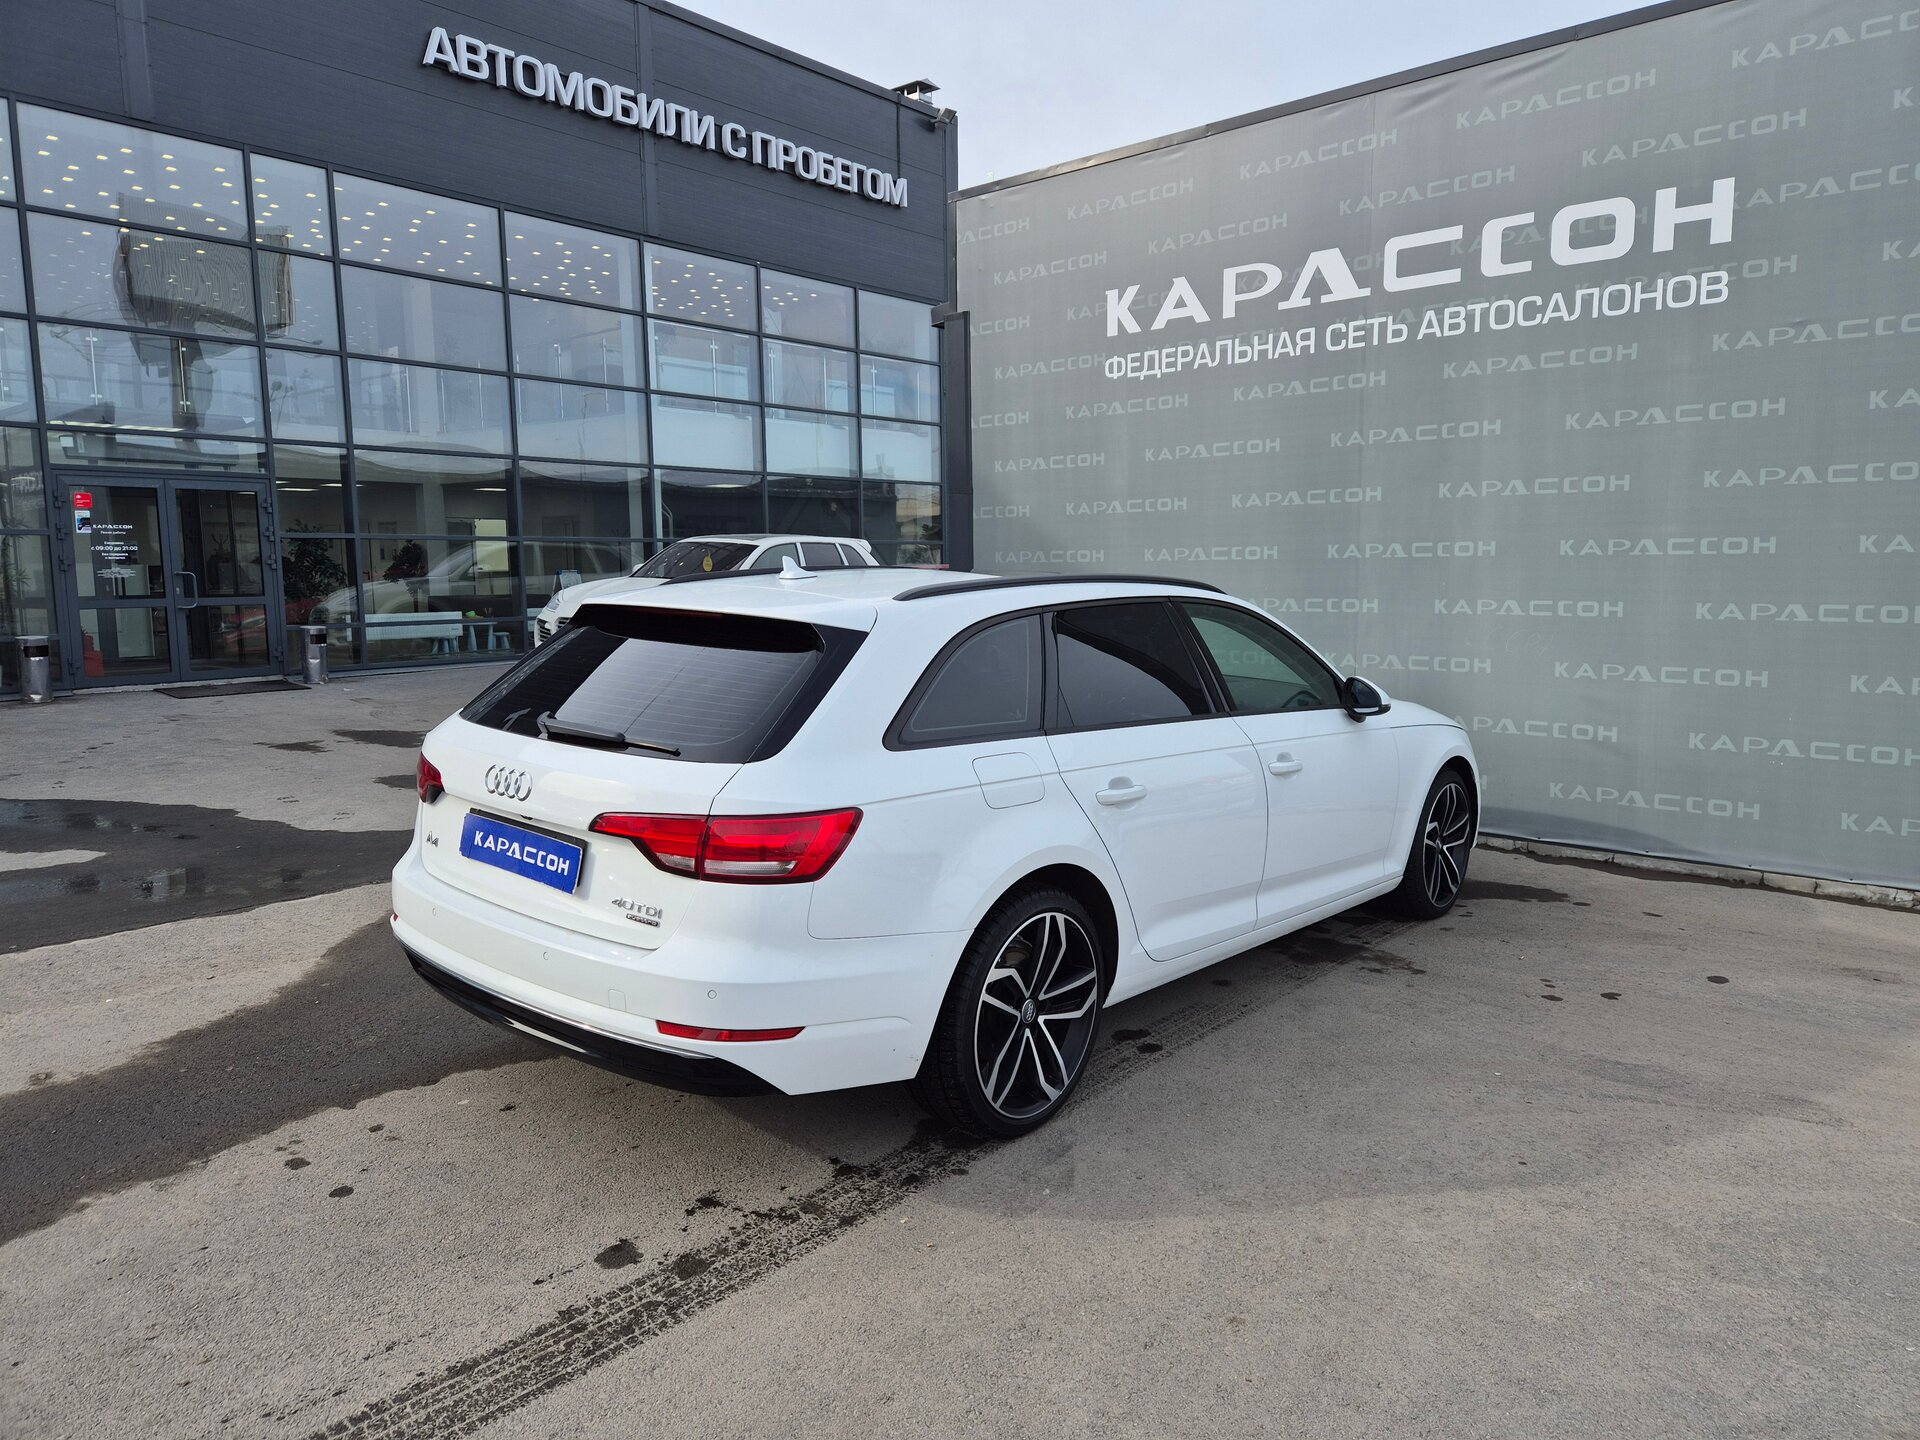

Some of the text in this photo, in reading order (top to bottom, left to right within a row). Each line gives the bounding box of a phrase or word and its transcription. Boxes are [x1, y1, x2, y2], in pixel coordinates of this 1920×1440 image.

[1456, 69, 1656, 129] КАРАССОН
[422, 26, 908, 207] АВТОМОБИЛИ С ПРОБЕГОМ
[1581, 108, 1807, 168] КАРАССОН
[1240, 128, 1397, 180] КАРАССОН
[1067, 177, 1194, 220] КАРАССОН
[1339, 164, 1515, 216] КАРАССОН
[1735, 161, 1920, 210] АРАСС
[1148, 212, 1288, 255] КАРАССОН
[994, 250, 1107, 285] КАРАССОН
[1105, 177, 1735, 337] КАРАССОН
[1104, 326, 1316, 381] ФЕДЕРАЛЬНАЯ
[1324, 315, 1409, 352] СЕТЬ
[1416, 270, 1730, 340] АВТОСАЛОНОВ
[1443, 343, 1638, 379] КАРАССОН
[1233, 370, 1386, 401] КАРАССОН
[972, 411, 1030, 429] ССОН
[1066, 394, 1188, 419] КАРАССОН
[1565, 397, 1786, 430] КАРАССОН
[1330, 419, 1501, 447] КАРАССОН
[994, 453, 1105, 472] КАРАССОН
[1145, 437, 1280, 462] КАРАССОН
[1231, 486, 1382, 508] КАРАССОН
[1438, 474, 1630, 498] КАРАССОН
[974, 505, 1030, 519] ССОН
[1066, 497, 1187, 515] КАРАССОН
[995, 549, 1105, 563] КАРАССОН
[1144, 545, 1278, 562] КАРАССОН
[1327, 540, 1496, 559] КАРАССОН
[1559, 536, 1776, 556] КАРАССОН
[1434, 598, 1624, 618] КАРАССОН
[1696, 602, 1920, 624] КАРАССО
[1554, 661, 1768, 688] КАРАССОН
[1549, 782, 1760, 820] КАРАССОН
[426, 831, 439, 848] A4
[474, 831, 570, 876] КАРАССОН
